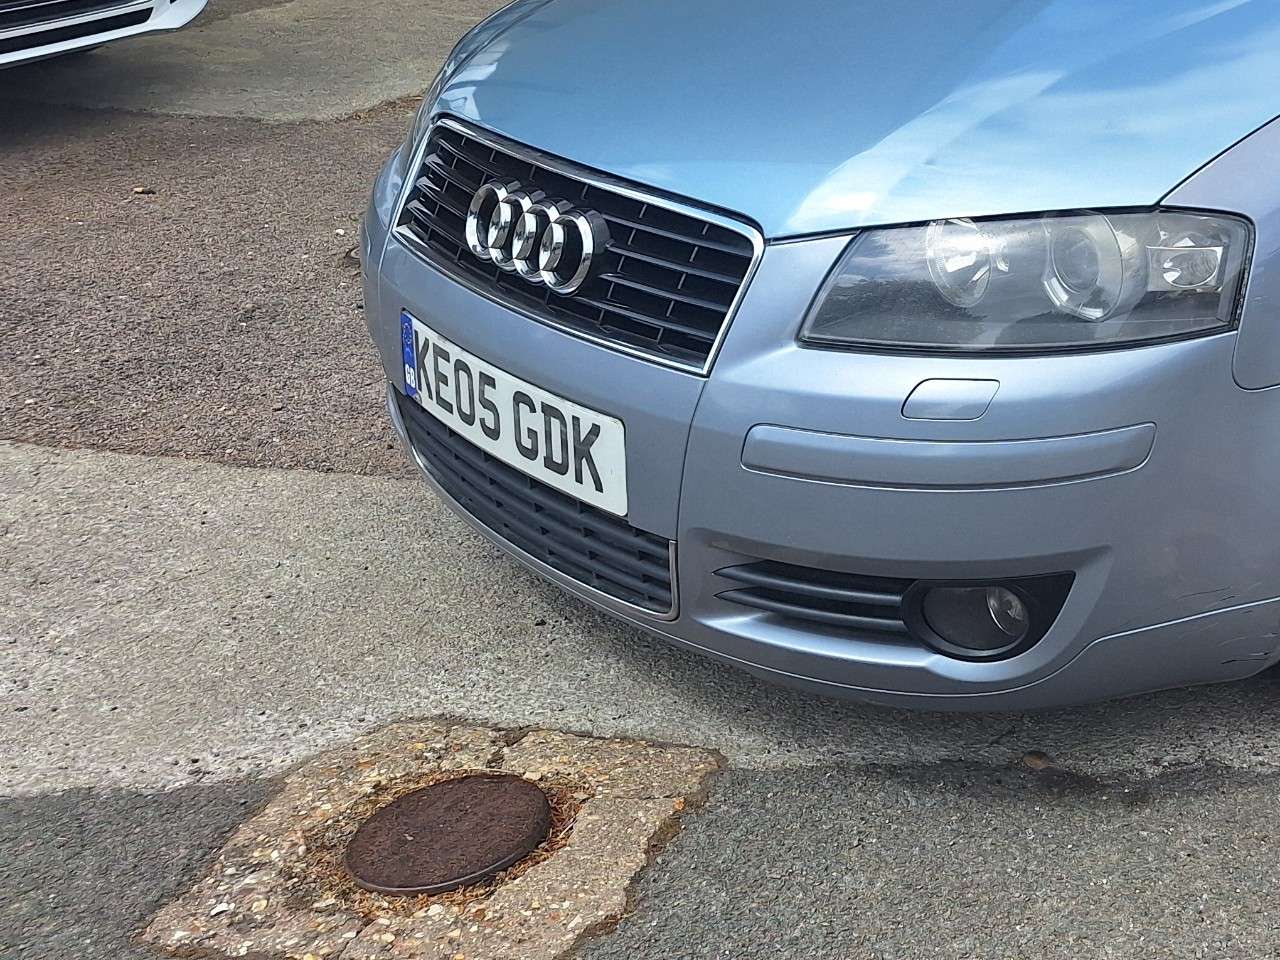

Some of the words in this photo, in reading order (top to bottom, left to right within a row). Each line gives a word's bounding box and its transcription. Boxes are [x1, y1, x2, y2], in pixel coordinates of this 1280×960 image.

[405, 364, 416, 388] GB
[414, 329, 501, 442] KE05
[512, 389, 604, 494] GDK
